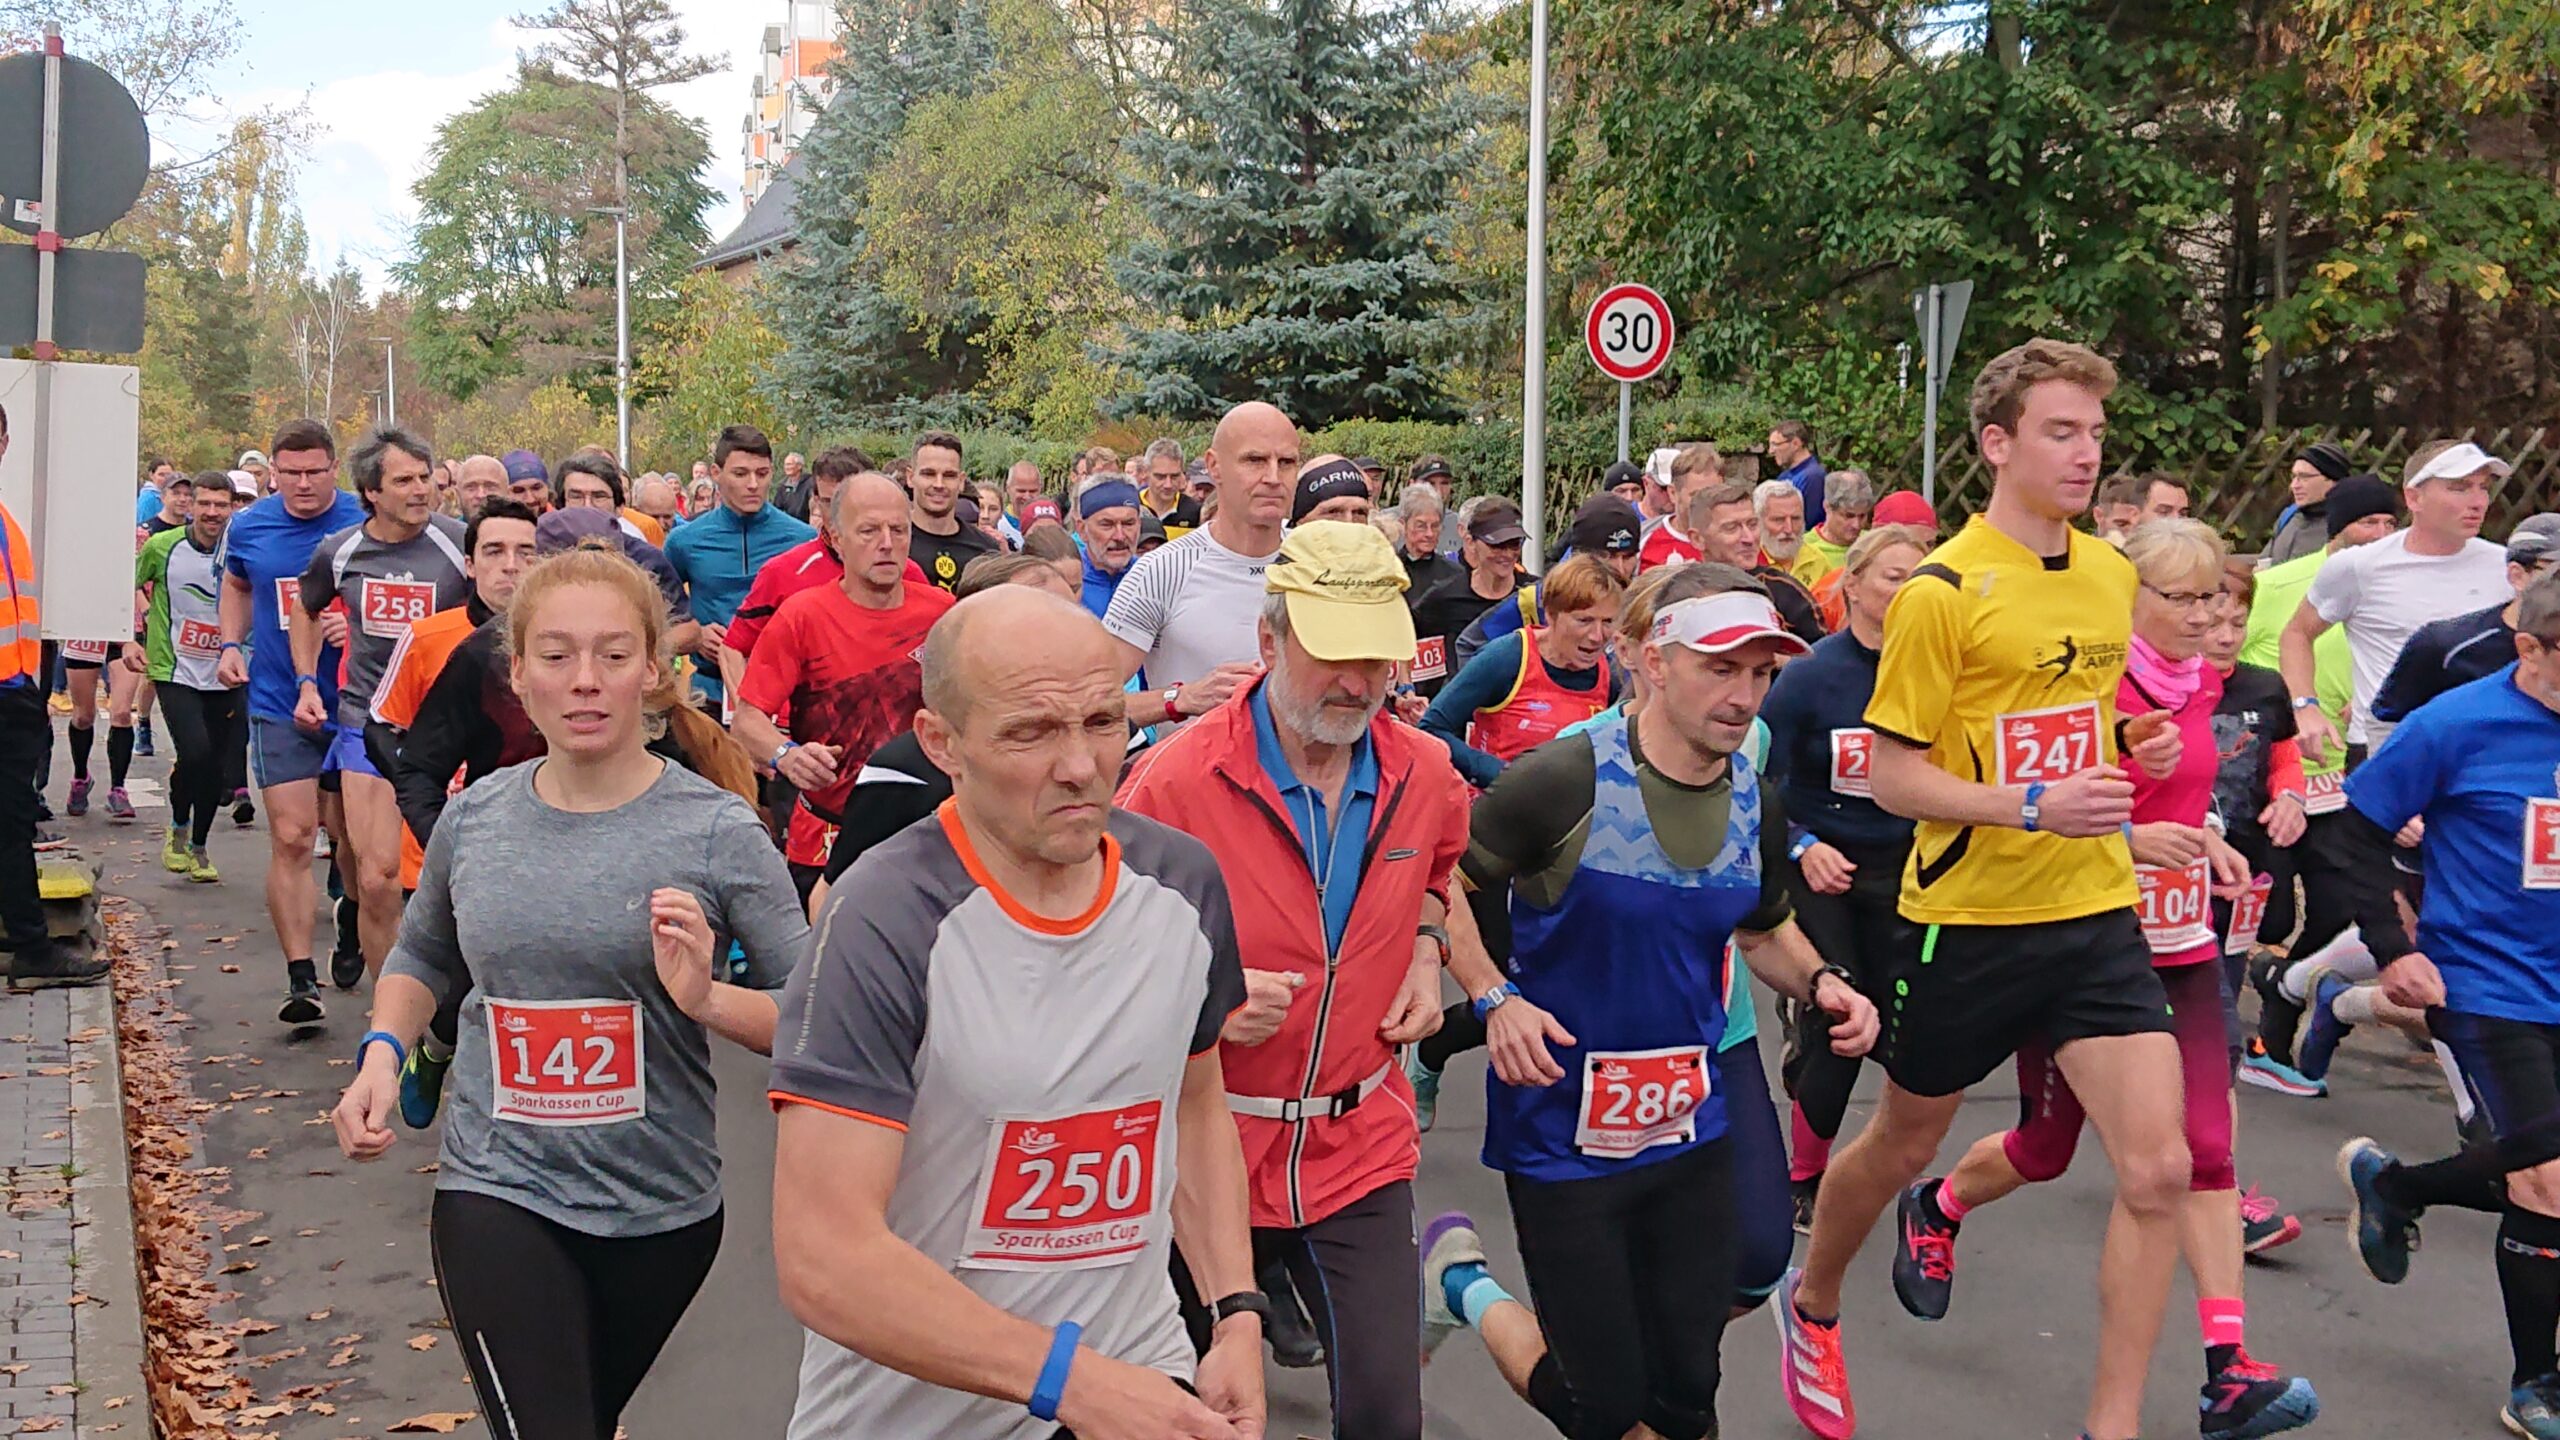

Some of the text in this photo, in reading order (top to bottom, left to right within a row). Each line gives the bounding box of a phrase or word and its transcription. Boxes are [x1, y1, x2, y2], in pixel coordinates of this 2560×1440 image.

[1606, 311, 1653, 353] 30
[938, 559, 953, 571] BVB
[371, 595, 425, 620] 258
[185, 628, 221, 649] 308
[1413, 647, 1442, 668] 103
[2015, 731, 2089, 778] 247
[2140, 885, 2199, 924] 104
[510, 1036, 618, 1086] 142
[511, 1092, 625, 1109] Sparkassen Cup
[1601, 1078, 1693, 1125] 286
[1004, 1143, 1142, 1220] 250
[994, 1223, 1140, 1249] Sparkassen Cup
